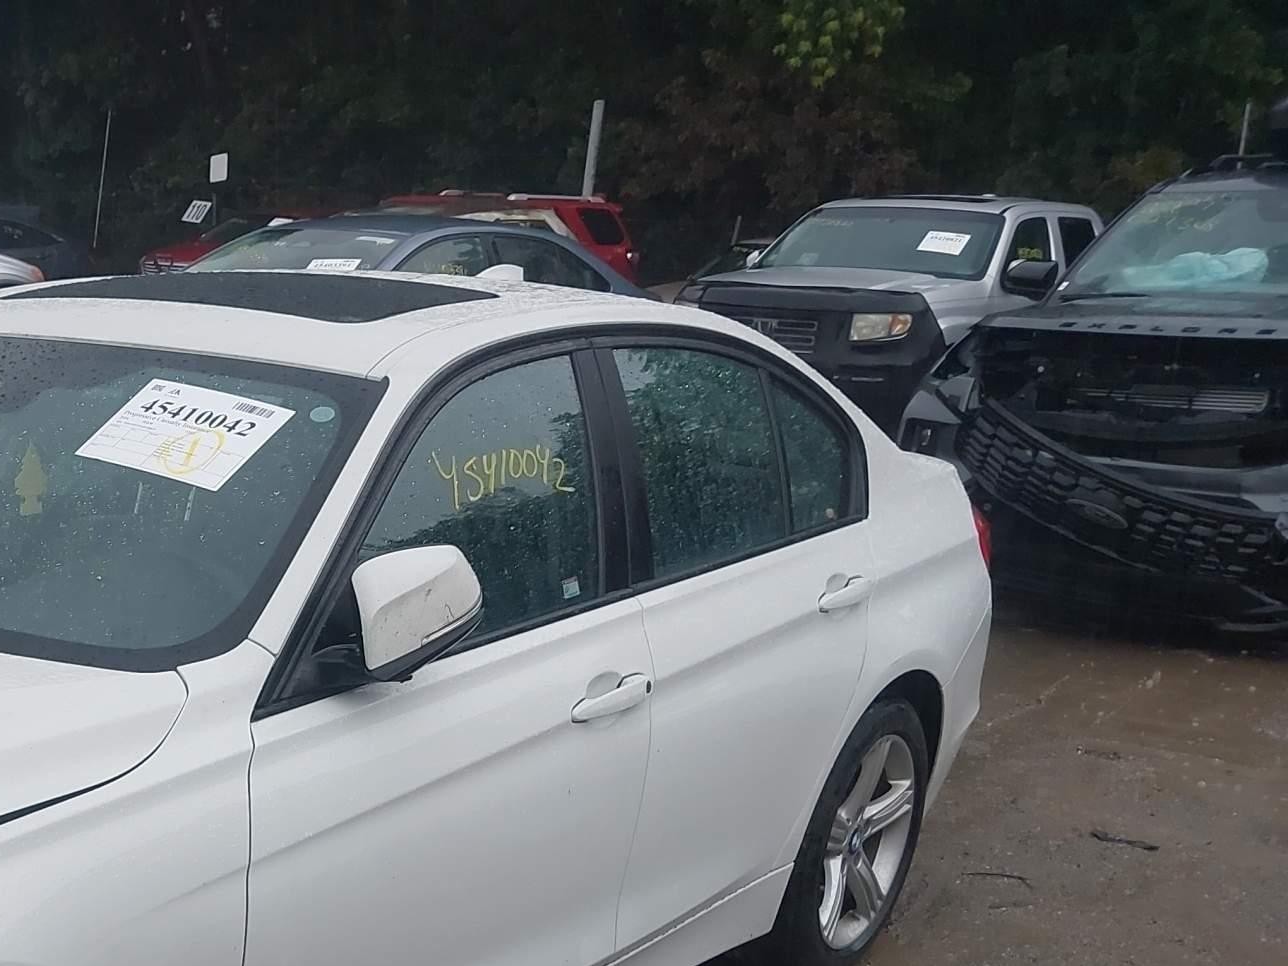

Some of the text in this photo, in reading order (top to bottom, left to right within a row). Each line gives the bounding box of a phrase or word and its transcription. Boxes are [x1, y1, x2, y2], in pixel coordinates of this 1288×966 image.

[186, 202, 208, 221] 110
[140, 399, 257, 437] 45410042
[431, 444, 576, 511] 45410042
